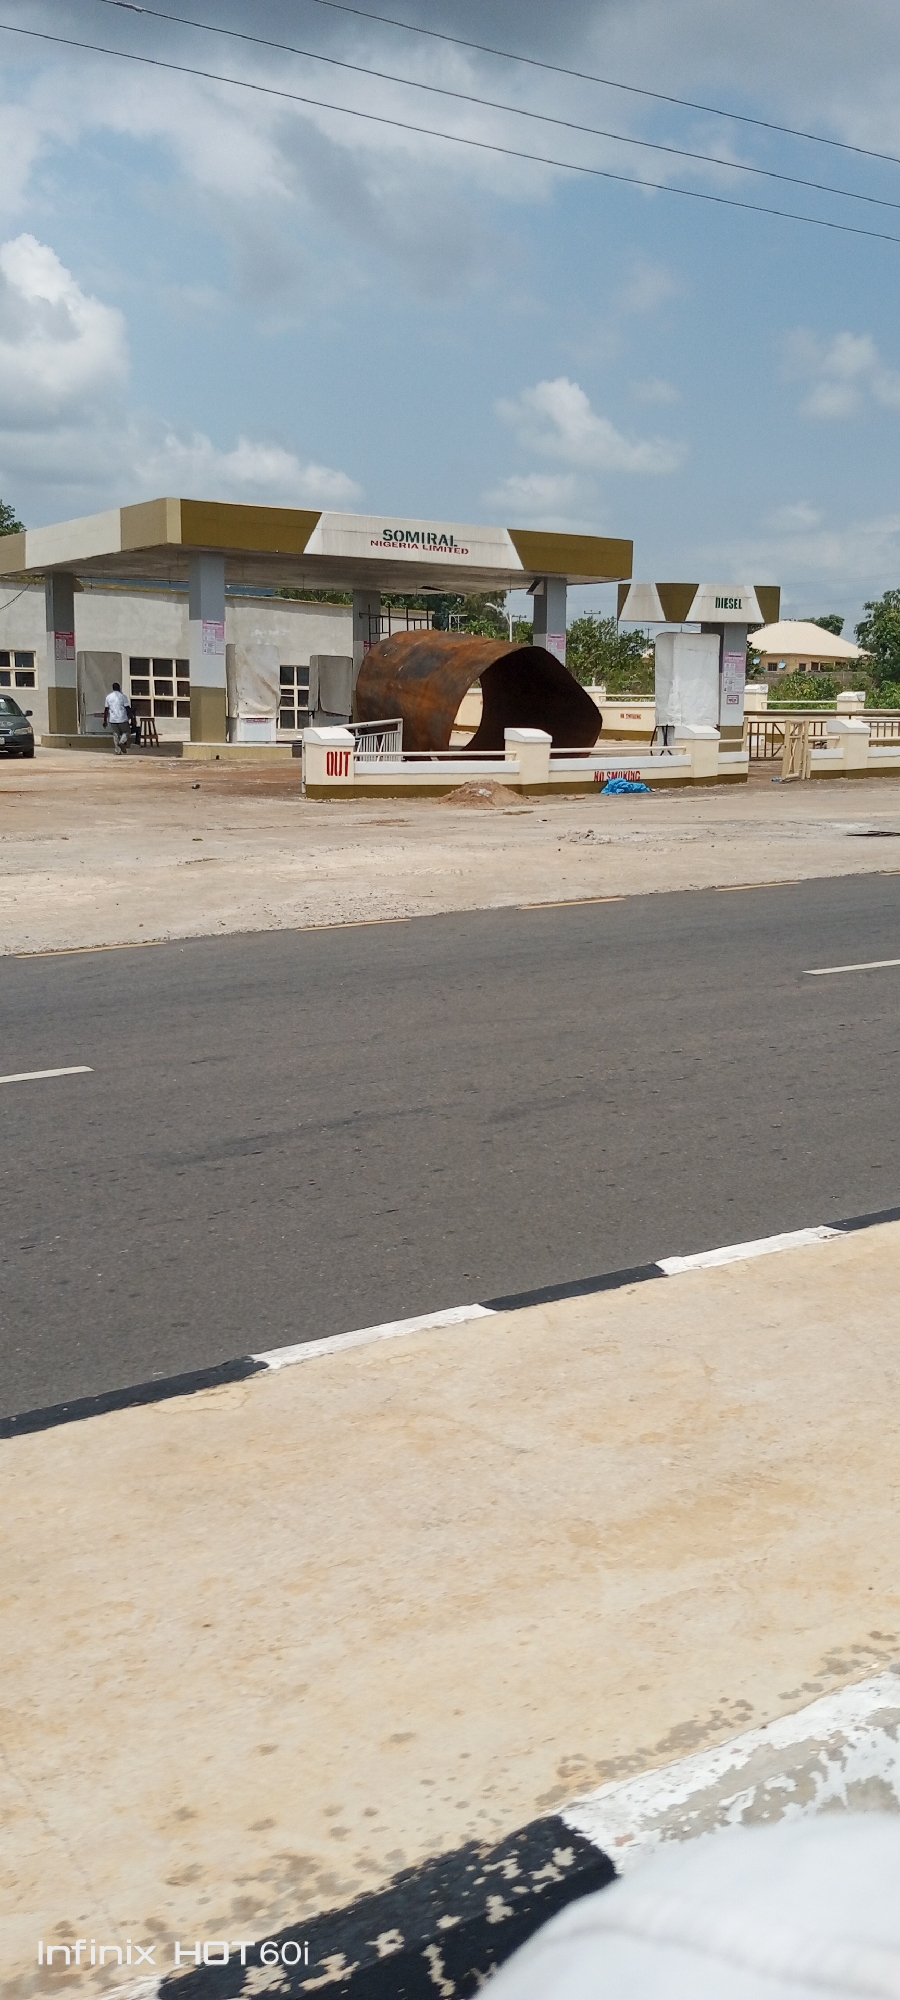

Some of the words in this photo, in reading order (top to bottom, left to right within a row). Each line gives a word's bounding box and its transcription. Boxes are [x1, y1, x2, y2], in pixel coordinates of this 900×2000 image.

[382, 529, 458, 547] SOMIRAL
[370, 540, 419, 549] NIGERIA
[422, 544, 469, 555] LIMITED
[715, 596, 742, 610] DIESEL
[326, 751, 351, 777] OUT
